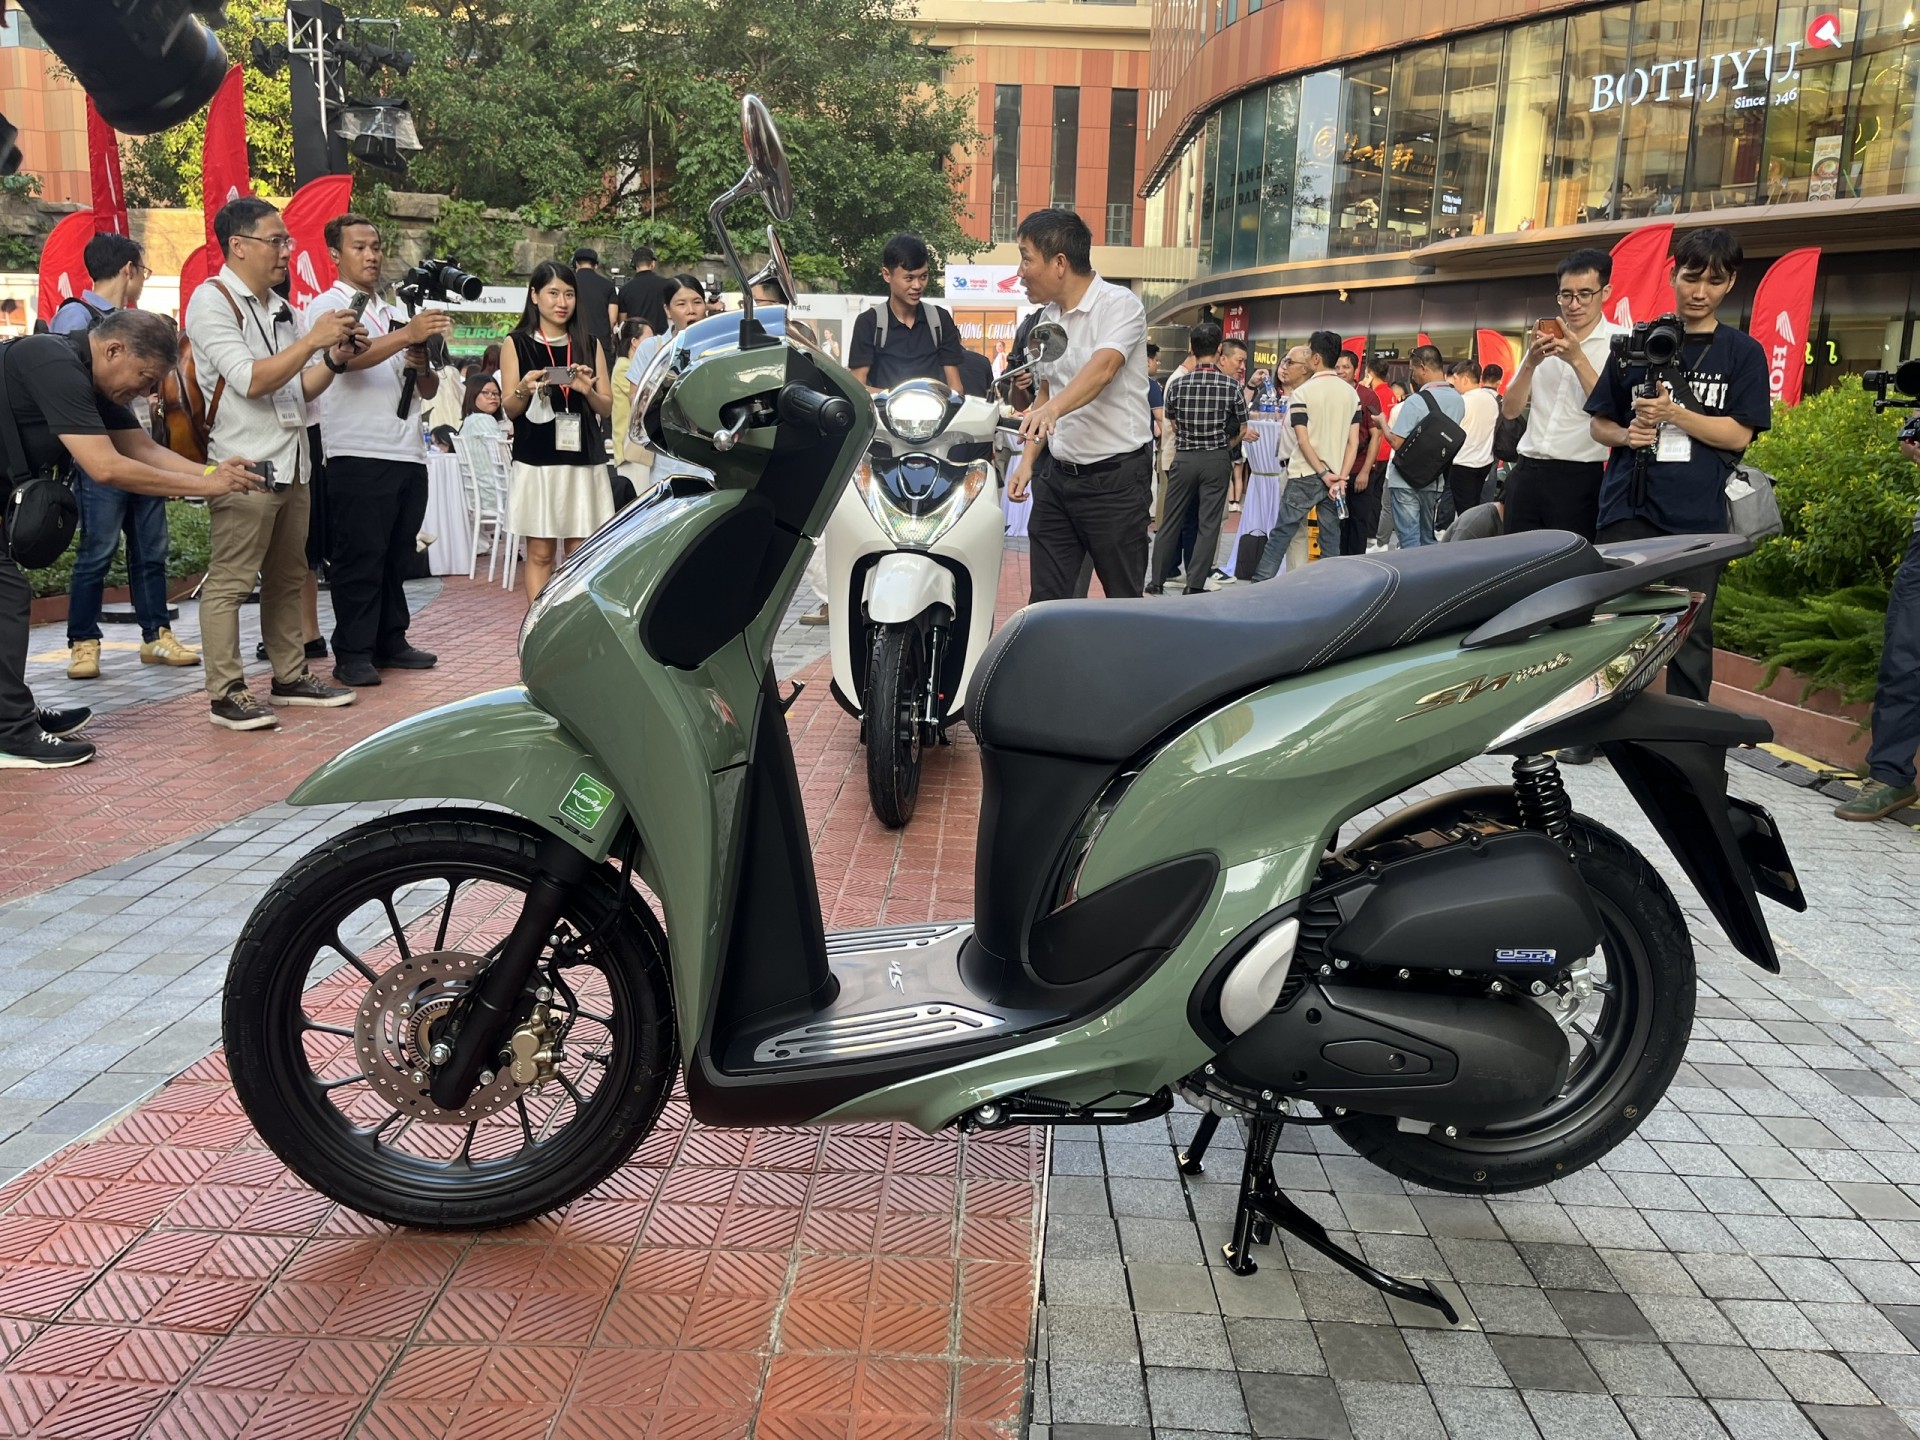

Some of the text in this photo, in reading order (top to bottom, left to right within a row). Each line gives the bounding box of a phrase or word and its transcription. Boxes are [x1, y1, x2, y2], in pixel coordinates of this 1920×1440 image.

[1734, 95, 1766, 109] Since
[488, 296, 506, 304] Xanh
[547, 814, 596, 844] ABS
